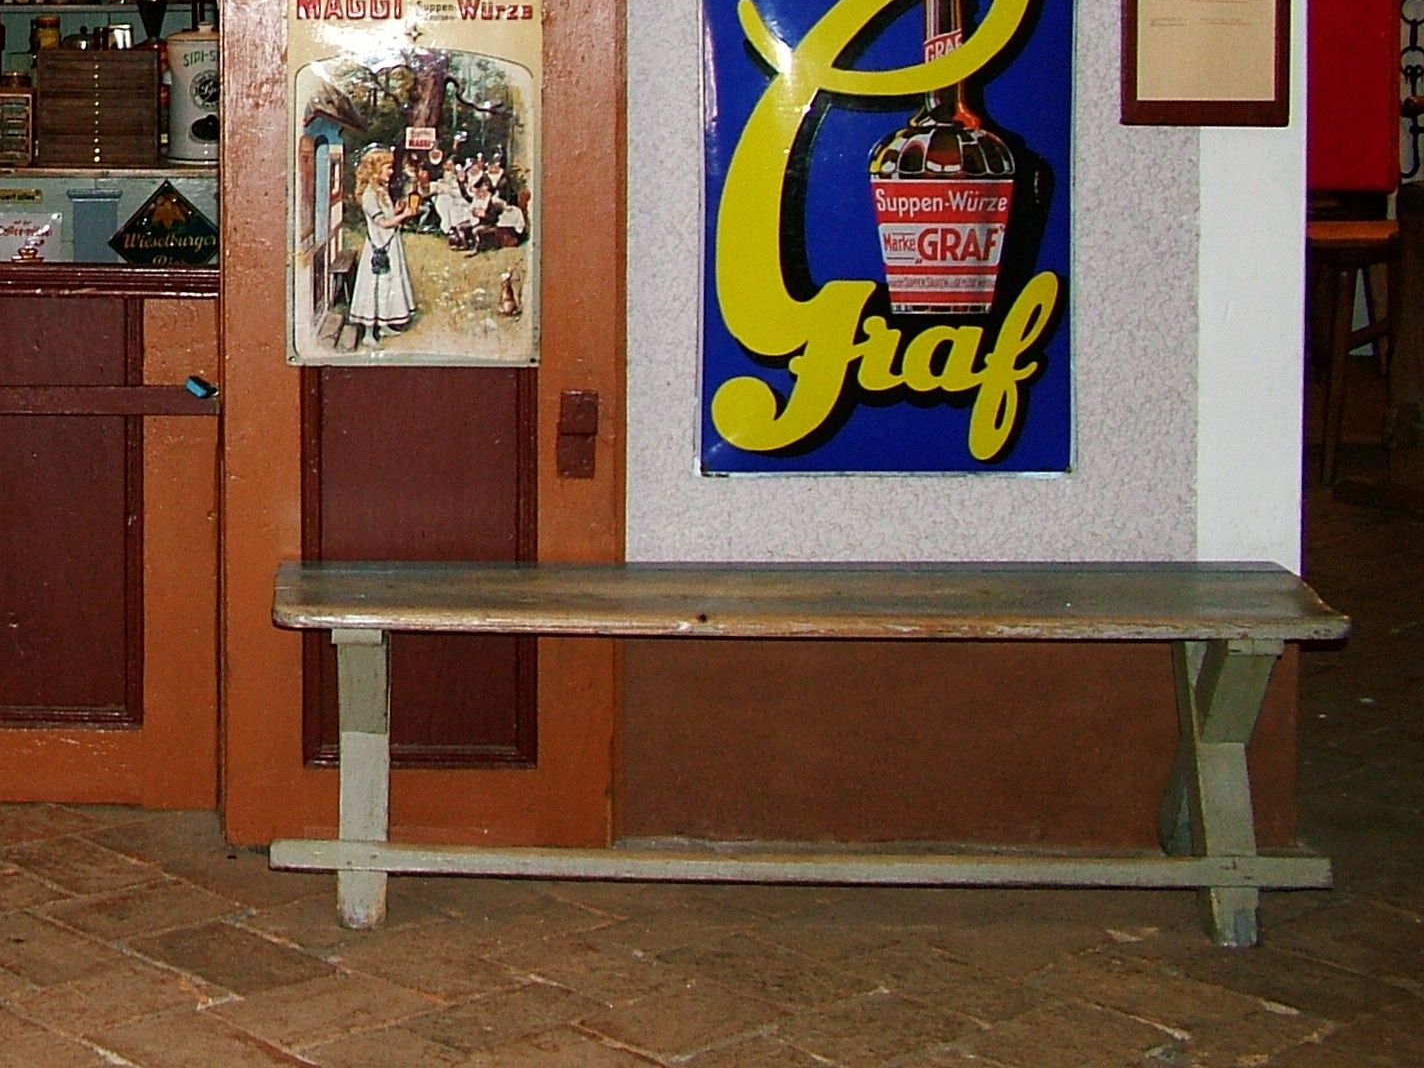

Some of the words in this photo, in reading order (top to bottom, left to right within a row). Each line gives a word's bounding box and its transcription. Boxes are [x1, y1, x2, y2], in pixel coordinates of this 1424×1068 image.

[875, 188, 1008, 218] Suppen-Würze
[123, 232, 217, 252] Wieselburger
[883, 233, 916, 251] Marke
